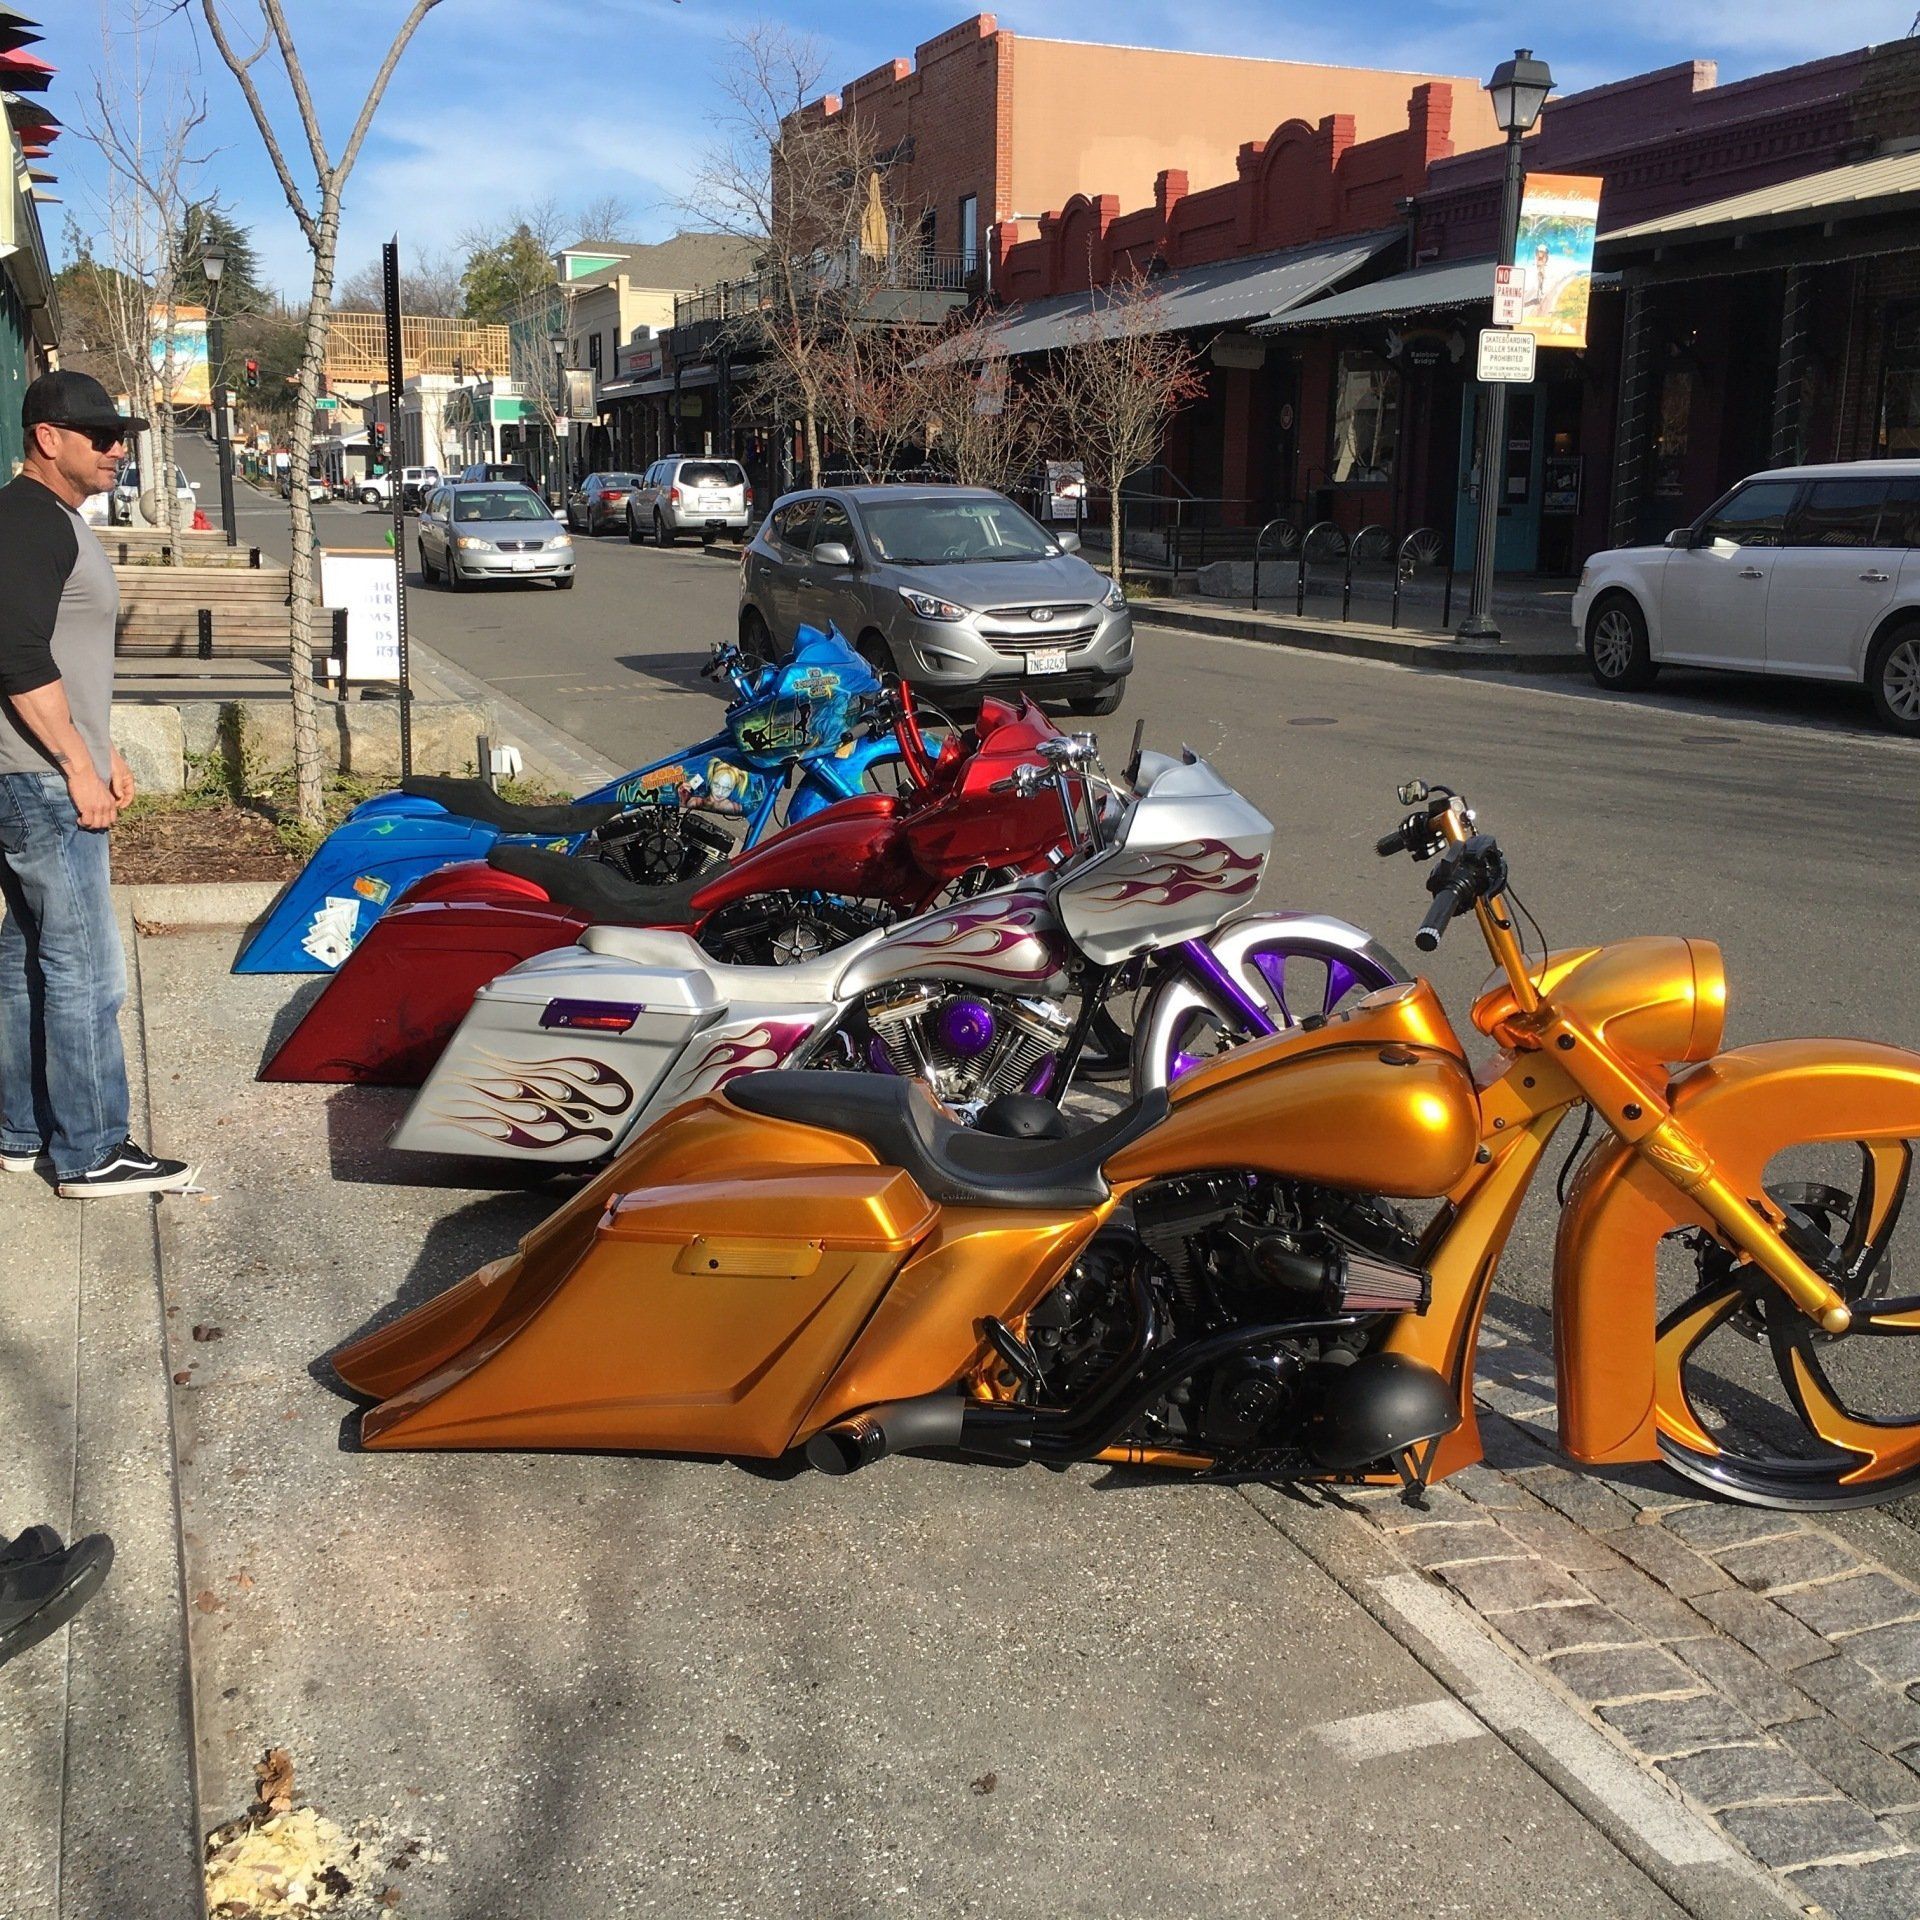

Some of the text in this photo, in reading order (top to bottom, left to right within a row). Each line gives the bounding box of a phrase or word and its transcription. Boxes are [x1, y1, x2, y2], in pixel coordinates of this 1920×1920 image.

[1498, 269, 1509, 283] NO
[1497, 286, 1522, 298] PARKING
[1503, 299, 1515, 307] ANY
[1502, 309, 1514, 318] TIME
[1485, 335, 1531, 344] SKATEBOARDING
[1483, 345, 1505, 353] ROLLER
[1489, 354, 1523, 362] PROHIBITED
[1510, 441, 1530, 449] OPEN
[1028, 657, 1065, 671] 7NEJ249
